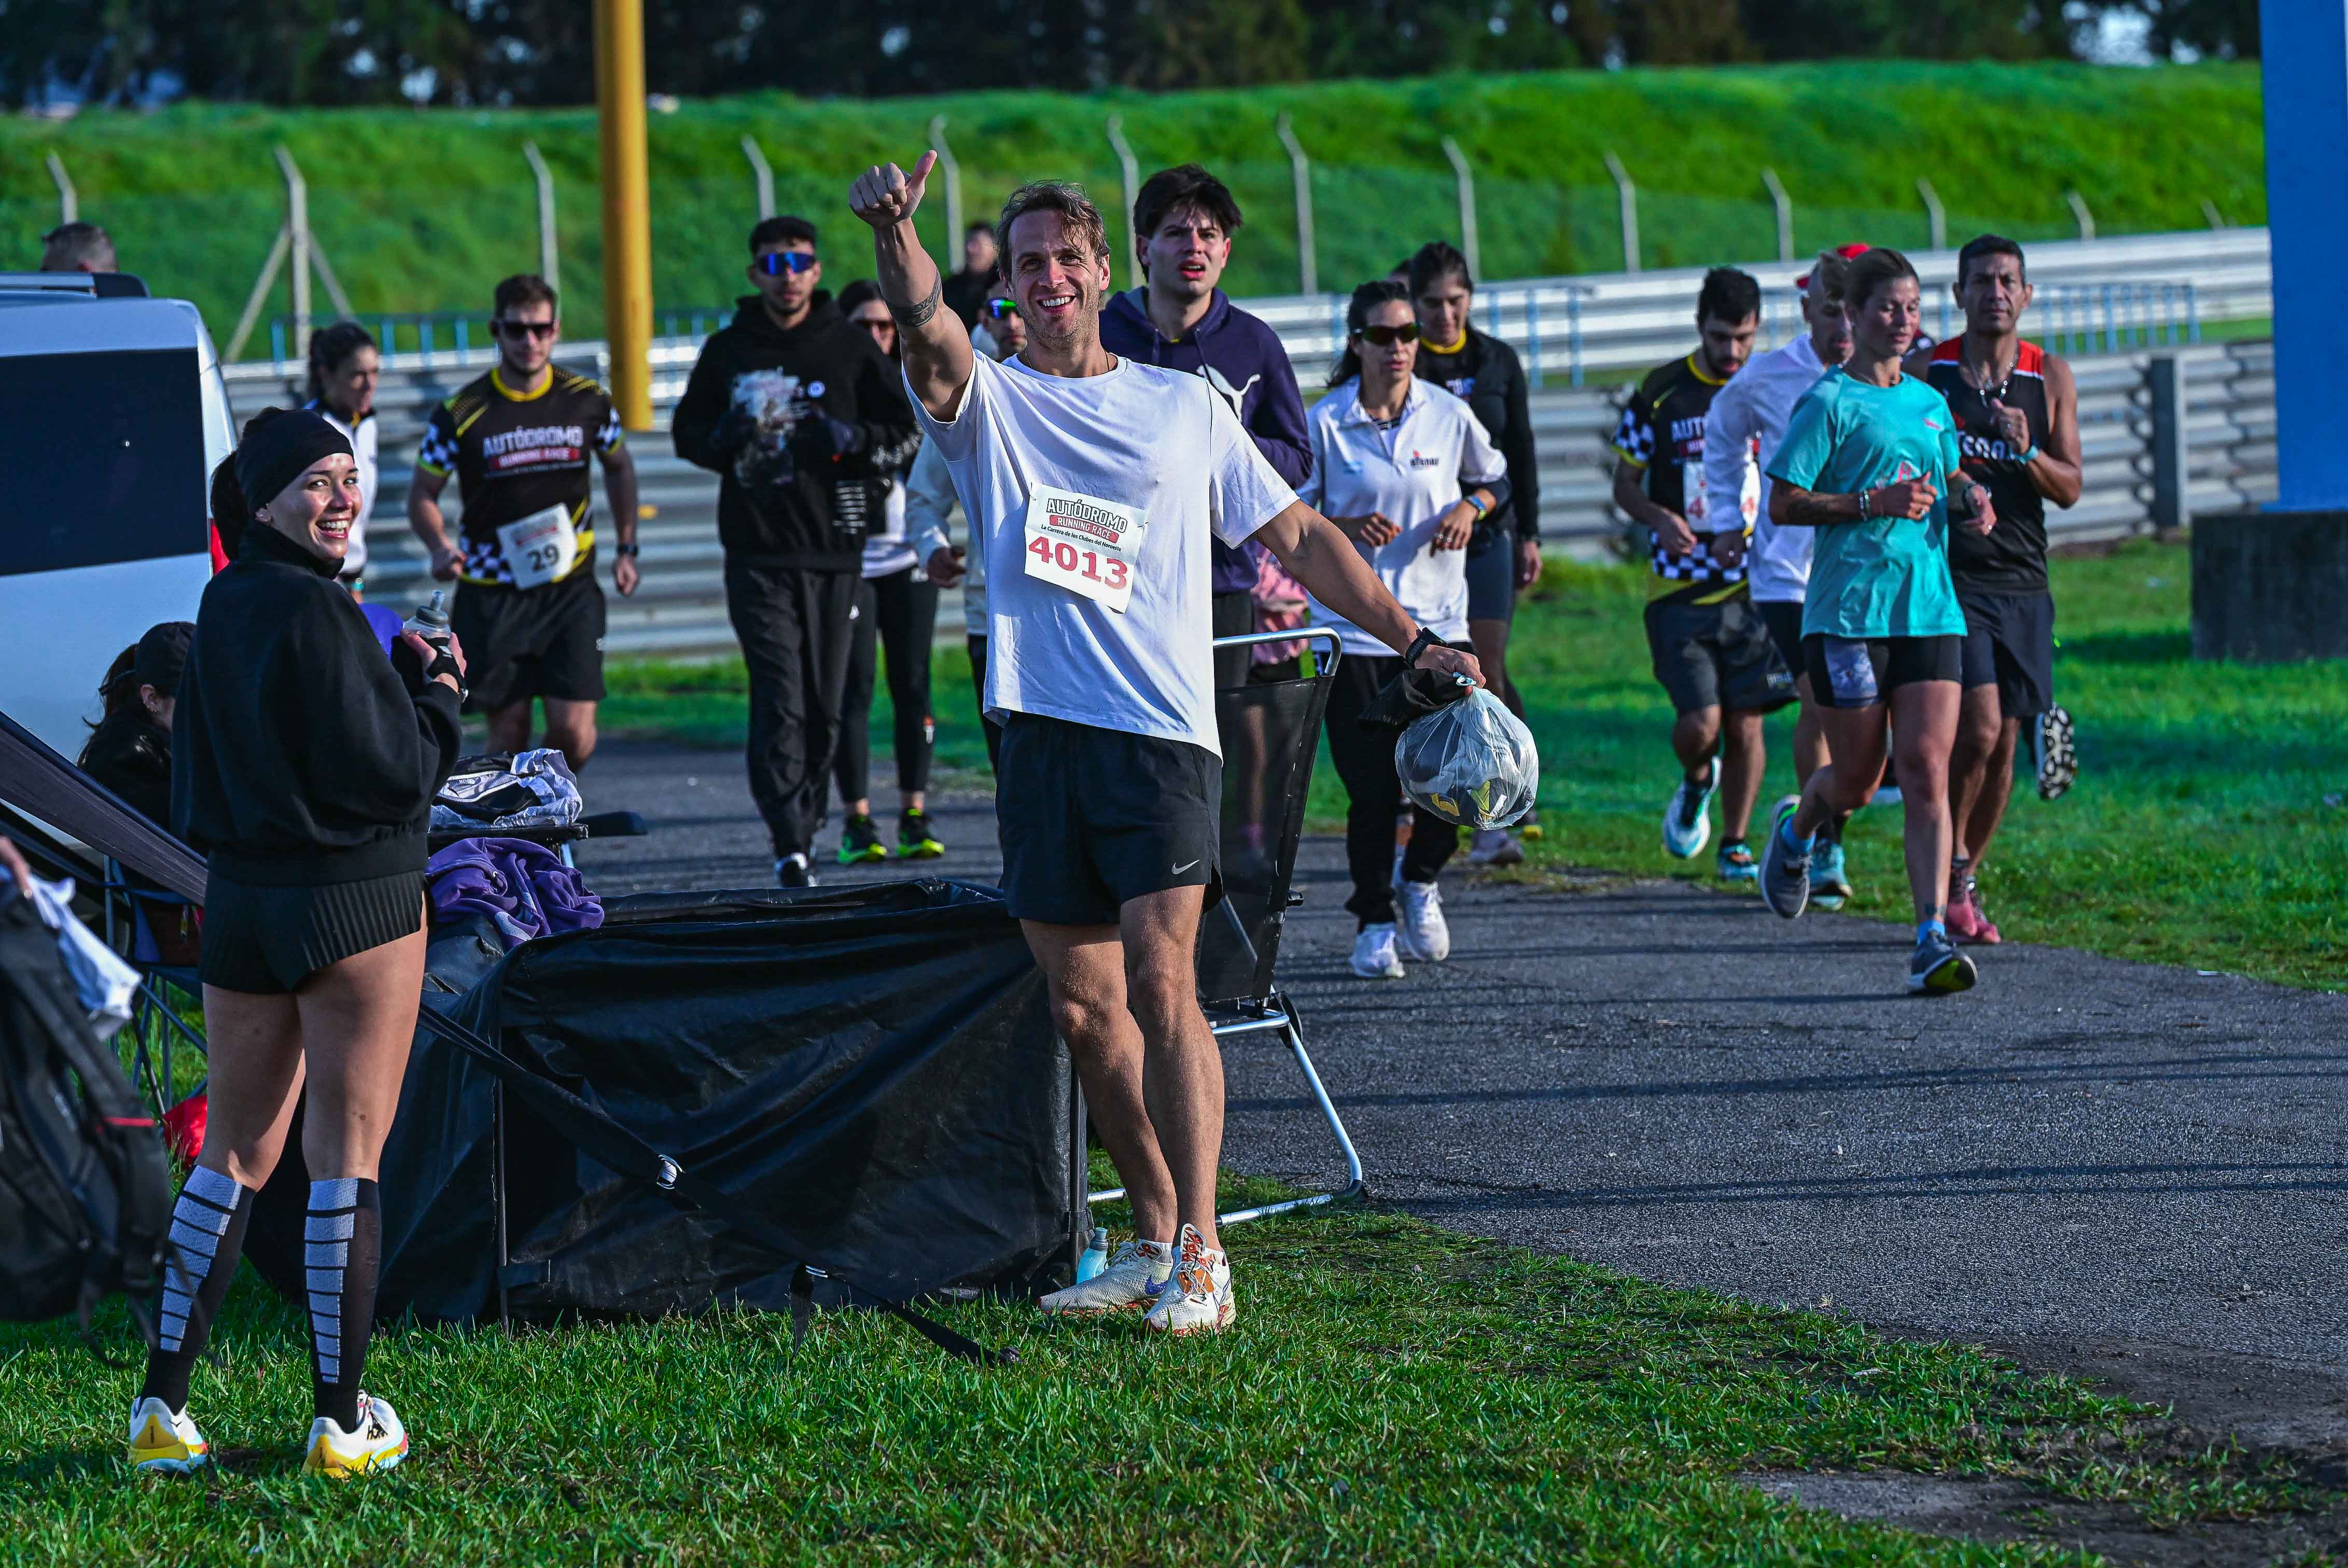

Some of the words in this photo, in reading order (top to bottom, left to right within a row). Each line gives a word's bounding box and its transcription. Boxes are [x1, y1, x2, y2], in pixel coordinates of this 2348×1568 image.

[1671, 416, 1708, 441] AUT
[1046, 498, 1128, 533] AUTÓDROMO
[1057, 517, 1091, 531] RUNNING
[1092, 525, 1112, 539] RACE
[1047, 526, 1064, 535] Carrera
[1079, 535, 1094, 543] Clubes
[1102, 542, 1121, 552] Noroeste
[527, 544, 560, 571] 29
[1029, 536, 1127, 590] 4013
